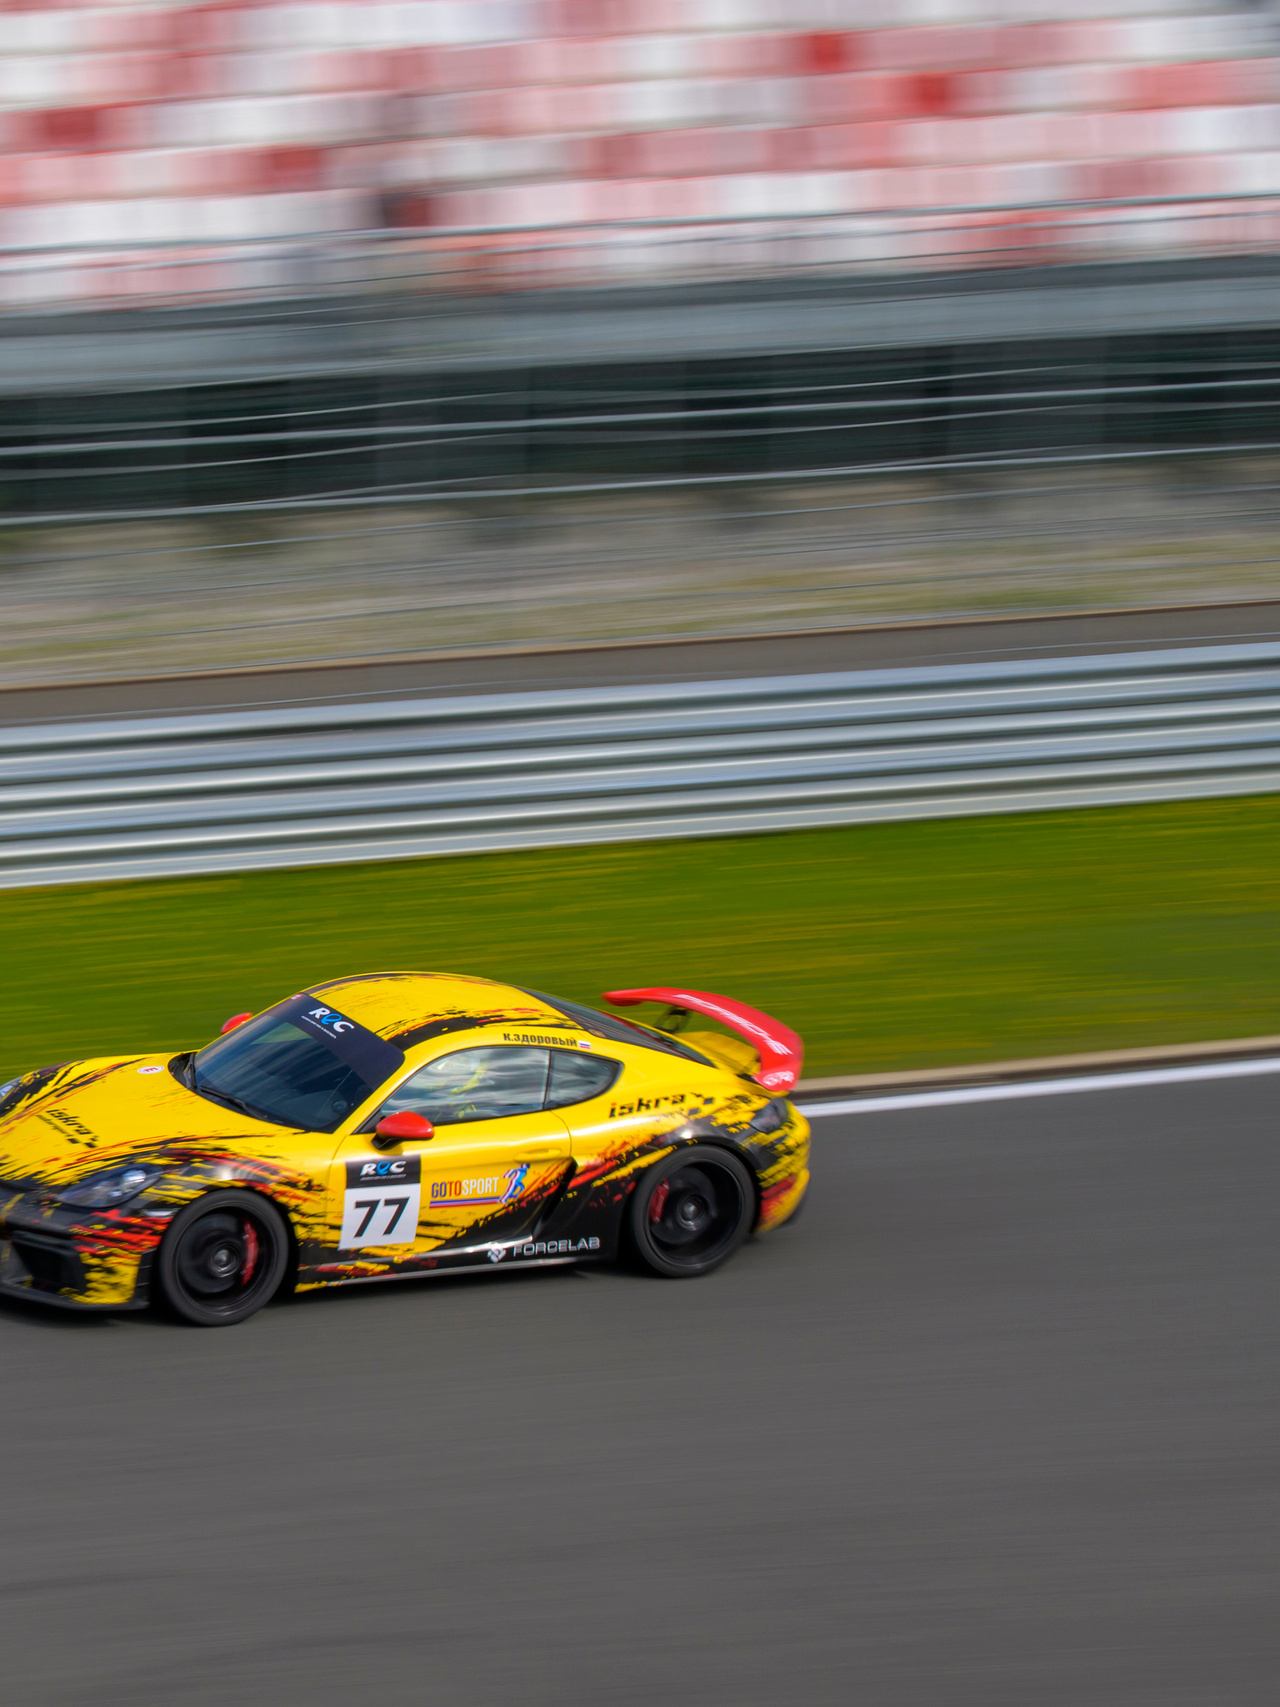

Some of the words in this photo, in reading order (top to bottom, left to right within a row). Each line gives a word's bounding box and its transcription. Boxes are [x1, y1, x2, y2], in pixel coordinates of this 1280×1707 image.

[609, 1094, 686, 1118] iskra
[45, 1108, 93, 1135] iskra
[431, 1176, 500, 1199] GOTOSPORT
[353, 1196, 411, 1240] 77
[513, 1236, 601, 1258] FORCELAB
